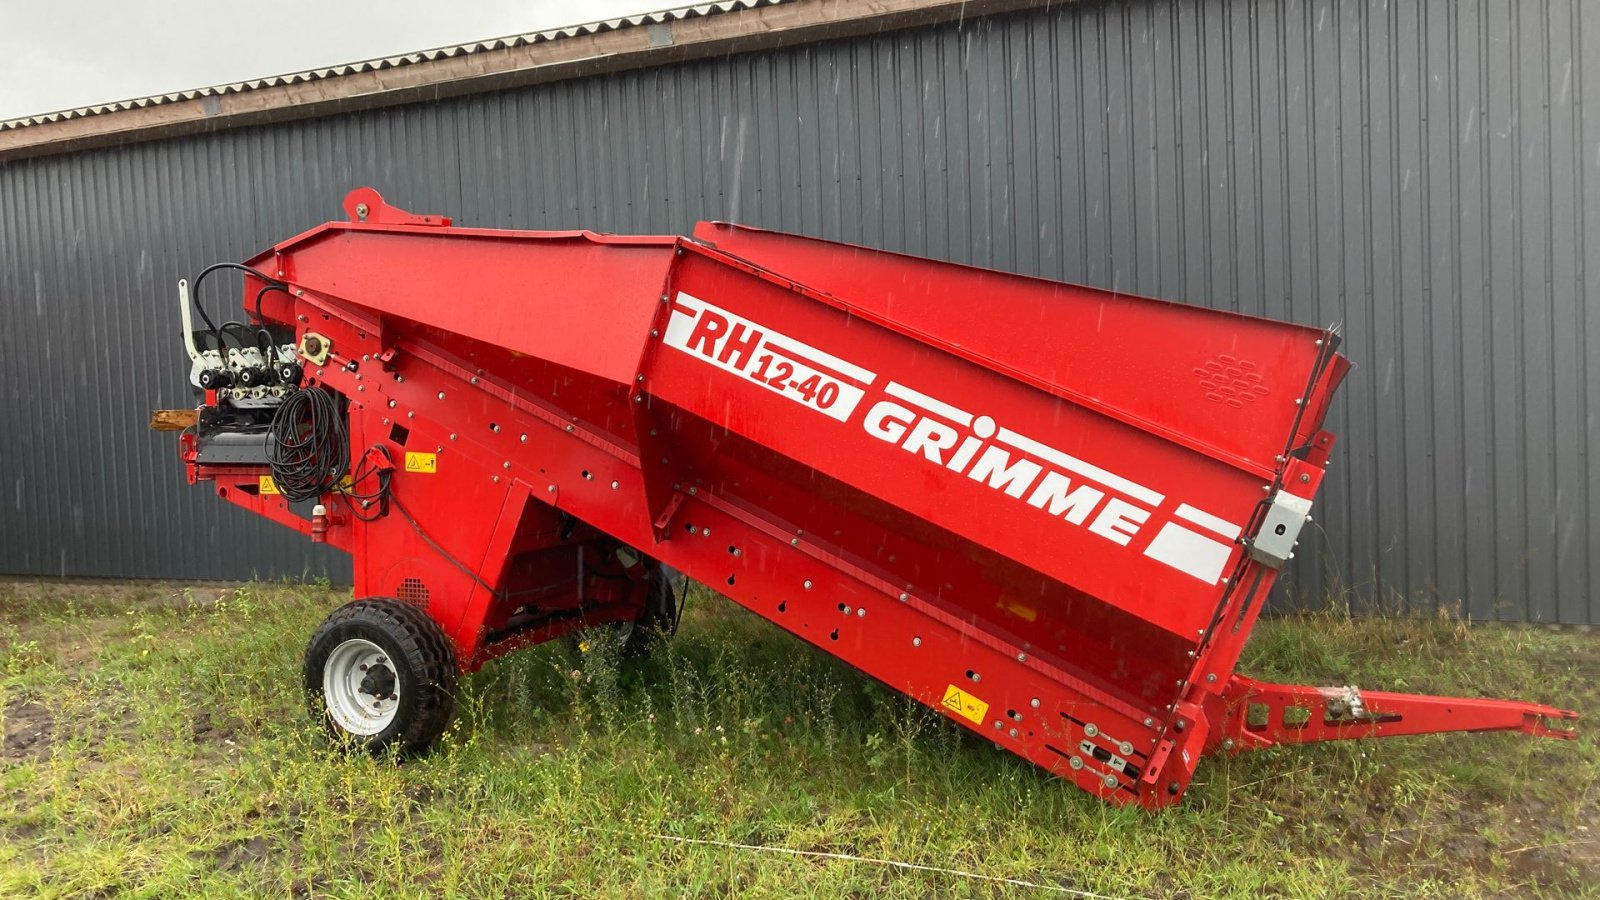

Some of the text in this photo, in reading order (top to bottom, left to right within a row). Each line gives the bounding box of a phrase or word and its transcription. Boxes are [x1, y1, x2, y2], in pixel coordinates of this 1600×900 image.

[686, 309, 840, 410] RH 12-40
[863, 401, 1152, 547] GRIMME
